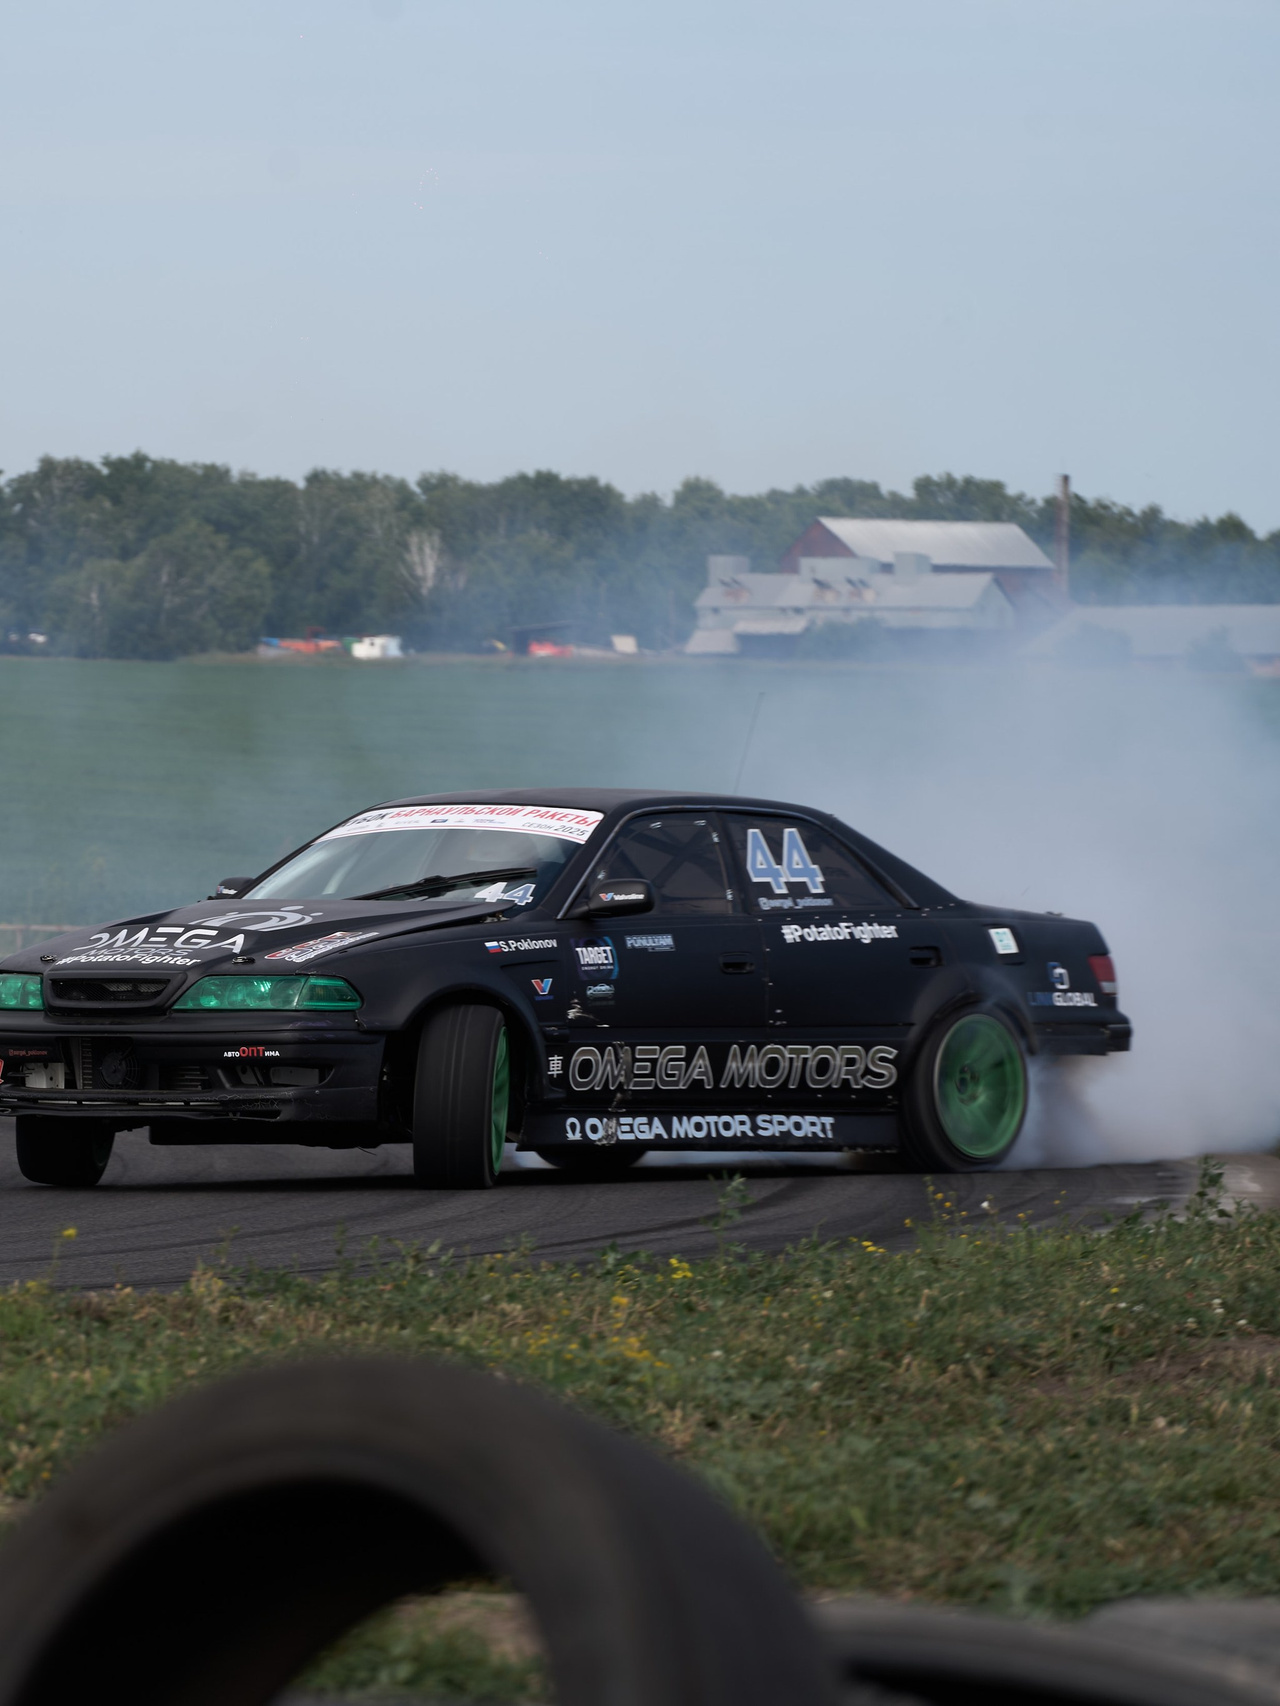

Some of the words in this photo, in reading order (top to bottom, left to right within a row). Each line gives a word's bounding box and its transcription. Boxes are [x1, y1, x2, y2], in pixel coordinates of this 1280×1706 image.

[389, 805, 527, 819] БАРНАУЛЬСКОЙ
[523, 808, 602, 827] РАКЕТЫ
[521, 821, 554, 831] СЕЗОН
[554, 823, 589, 837] 2025
[746, 828, 826, 894] 44
[474, 881, 537, 906] 44
[72, 927, 245, 955] OMEGA
[781, 922, 899, 943] #PotatoFighter
[500, 938, 558, 952] S.Poklonov
[575, 946, 614, 964] TARGET
[56, 953, 202, 966] #PotatoFighter
[547, 1055, 564, 1078] 車
[569, 1045, 714, 1091] OMEGA
[720, 1044, 899, 1089] MOTORS
[585, 1116, 669, 1140] OEGA
[672, 1115, 754, 1139] MOTOR
[757, 1114, 835, 1139] SPORT
